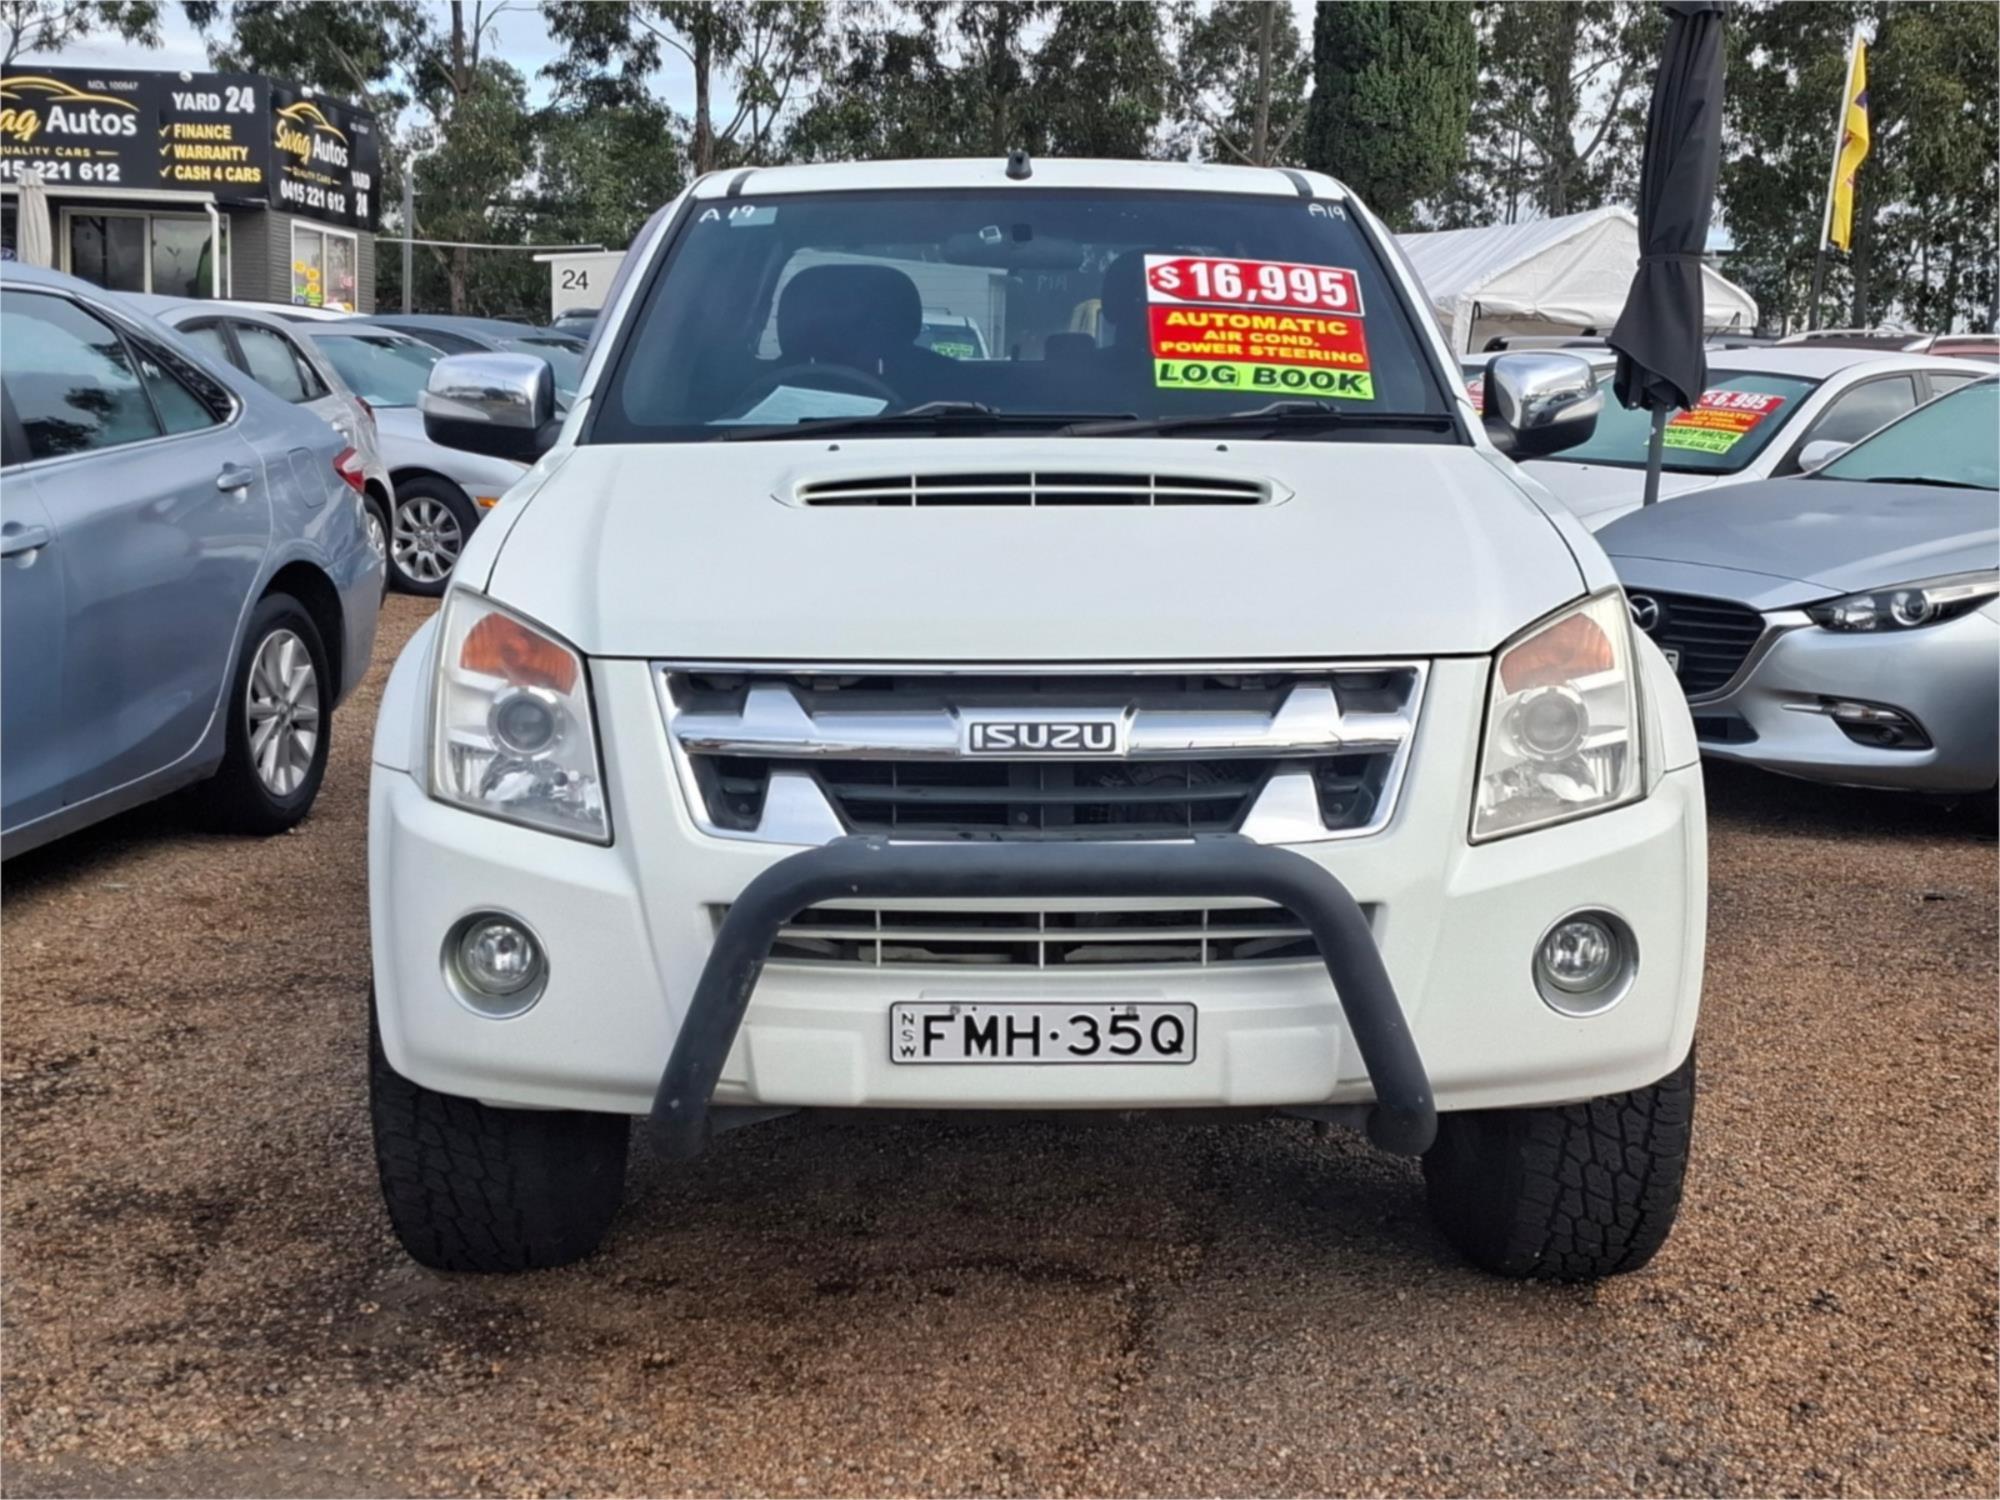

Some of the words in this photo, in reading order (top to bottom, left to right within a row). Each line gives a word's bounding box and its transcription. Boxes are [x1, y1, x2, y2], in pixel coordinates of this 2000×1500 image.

[172, 92, 221, 111] YARD
[224, 86, 255, 114] 24
[45, 105, 137, 136] Autos
[173, 123, 232, 140] FINANCE
[0, 145, 49, 156] UALITY
[55, 147, 91, 157] CARS
[173, 144, 248, 161] WARRANTY
[275, 118, 311, 166] Swag
[312, 133, 348, 168] Autos
[32, 160, 71, 179] 221
[79, 161, 120, 181] 612
[174, 164, 211, 180] CASH
[213, 165, 223, 181] 4
[224, 166, 262, 183] CARS
[280, 178, 305, 204] 0415
[306, 185, 325, 209] 221
[327, 190, 345, 214] 612
[355, 191, 369, 218] 24
[1307, 203, 1347, 222] A19
[561, 269, 589, 291] 24
[1164, 311, 1349, 337] AUTOMATIC
[1202, 330, 1244, 343] AIR
[1248, 332, 1321, 349] COND.
[1159, 341, 1244, 356] POWER
[1248, 346, 1365, 365] STEERING
[1158, 364, 1240, 386] LOG
[1252, 367, 1369, 396] BOOK
[973, 724, 1113, 750] ISUZU
[899, 1012, 917, 1057] NSW
